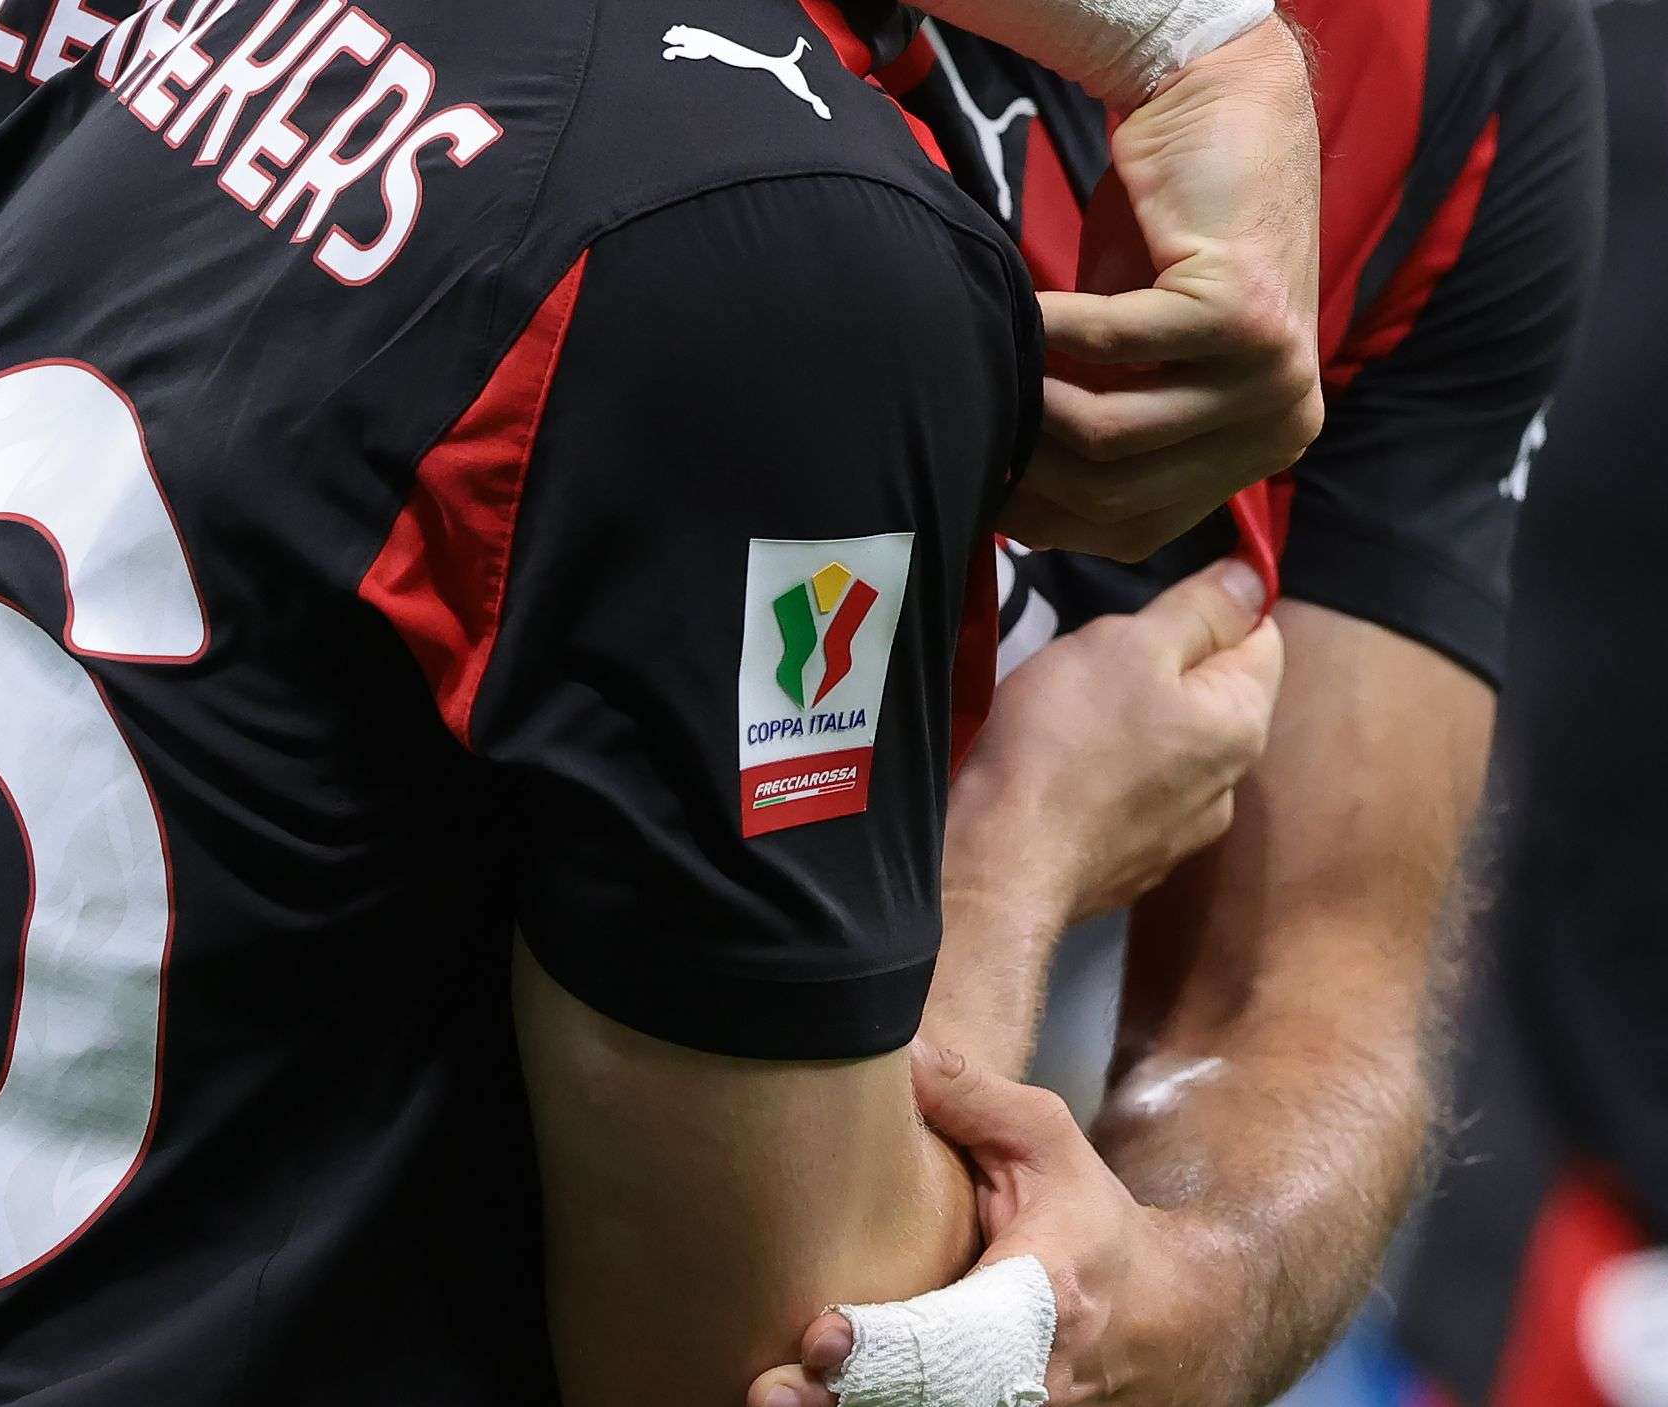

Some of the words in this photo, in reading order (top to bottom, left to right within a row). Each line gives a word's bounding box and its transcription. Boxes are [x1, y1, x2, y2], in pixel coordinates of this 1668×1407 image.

[747, 717, 804, 746] COPPA
[809, 708, 867, 736] ITALIA
[754, 766, 857, 798] FRECCIAROSSA
